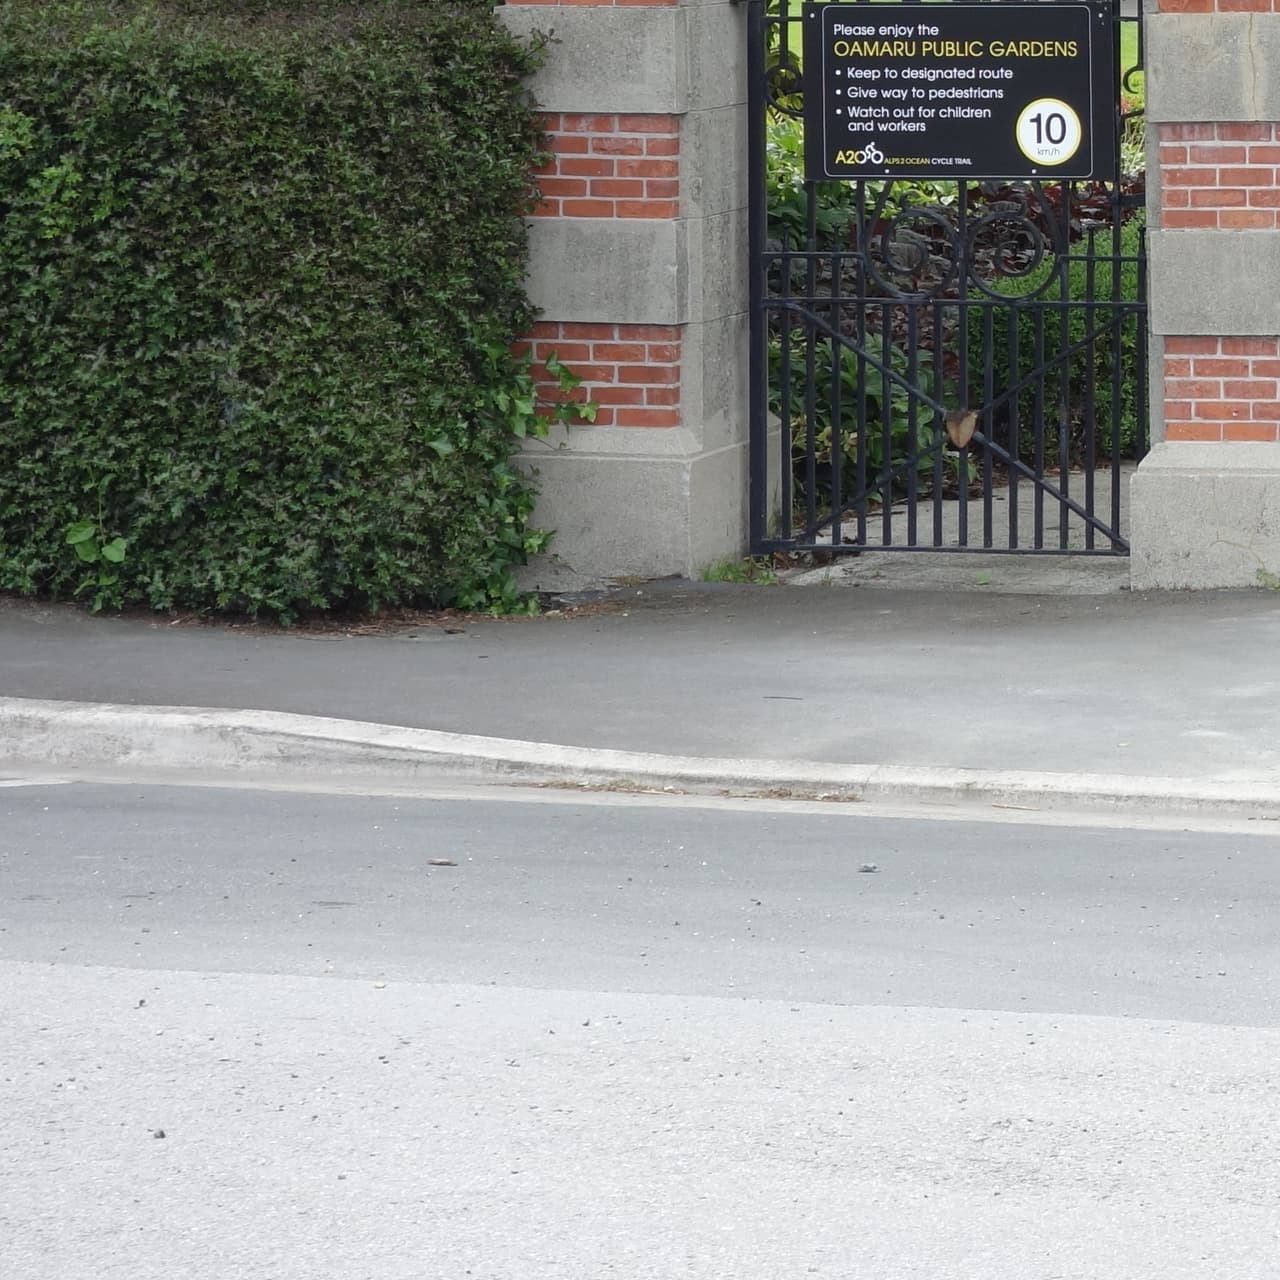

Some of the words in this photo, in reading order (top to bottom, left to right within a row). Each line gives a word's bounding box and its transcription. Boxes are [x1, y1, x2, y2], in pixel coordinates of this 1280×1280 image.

[833, 24, 875, 36] Please
[879, 24, 914, 38] enjoy
[918, 24, 939, 36] the
[834, 41, 916, 57] OAMARU
[922, 41, 984, 57] PUBLIC
[989, 41, 1078, 57] GARDENS
[847, 67, 881, 80] Keep
[884, 67, 898, 79] to
[901, 67, 976, 81] designated
[979, 67, 1014, 79] route
[847, 87, 878, 99] Give
[881, 89, 908, 101] way
[912, 87, 925, 99] to
[928, 87, 1004, 101] pedestrians
[847, 106, 889, 118] Watch
[893, 106, 915, 118] out
[918, 106, 935, 118] for
[939, 106, 991, 118] children
[847, 120, 874, 132] and
[877, 120, 926, 132] workers
[1029, 112, 1067, 145] 10
[1037, 147, 1060, 156] km/h
[931, 157, 953, 165] CYCLE
[954, 157, 972, 165] TRAIL
